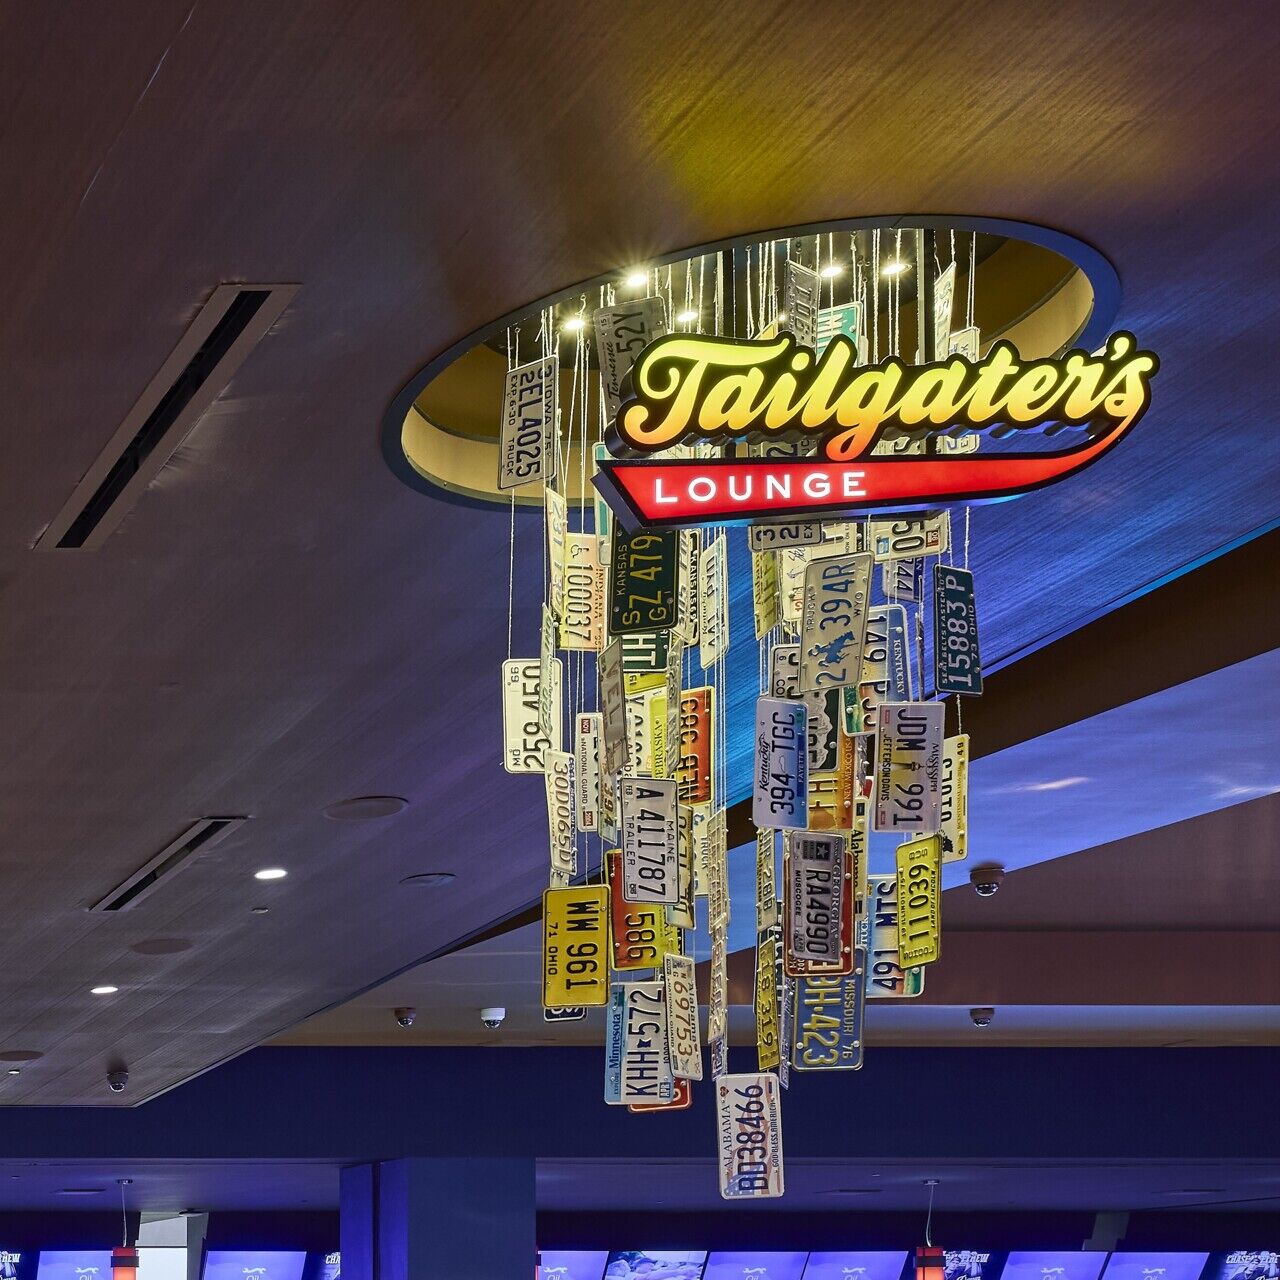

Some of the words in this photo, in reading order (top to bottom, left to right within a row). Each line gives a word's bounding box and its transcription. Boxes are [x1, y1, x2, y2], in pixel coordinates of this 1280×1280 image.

[606, 340, 620, 400] Tennessee
[622, 337, 1155, 460] Tailgater's
[506, 438, 515, 477] TRUCK
[655, 471, 867, 504] LOUNGE
[617, 543, 628, 597] KANSAS
[946, 574, 965, 592] P
[566, 564, 592, 640] 100037
[805, 593, 815, 633] TRUCK
[968, 604, 977, 636] OHIO
[893, 639, 905, 695] KENTUCKY
[946, 600, 972, 686] 15883
[771, 711, 795, 751] TGC
[897, 709, 927, 751] JDM
[759, 738, 770, 792] Kentucky
[797, 749, 805, 783] FAYETTE
[771, 773, 795, 815] 394
[893, 783, 923, 826] 991
[626, 815, 635, 866] TRAILER
[636, 809, 666, 896] 411787
[667, 821, 675, 863] MAINE
[794, 870, 802, 918] MUSCOGEE
[830, 864, 840, 934] GEORGIA
[908, 863, 929, 908] 039
[625, 912, 657, 960] 586
[804, 869, 830, 954] RA4990
[548, 946, 558, 976] OHIO
[566, 943, 598, 990] 961
[629, 989, 662, 1036] 572
[672, 982, 692, 1056] 69753
[687, 983, 697, 1043] Alabama
[844, 979, 856, 1036] MISSOURI
[609, 1013, 621, 1069] Minnesota
[720, 1104, 732, 1169] ALABAMA
[733, 1084, 769, 1191] BD38466
